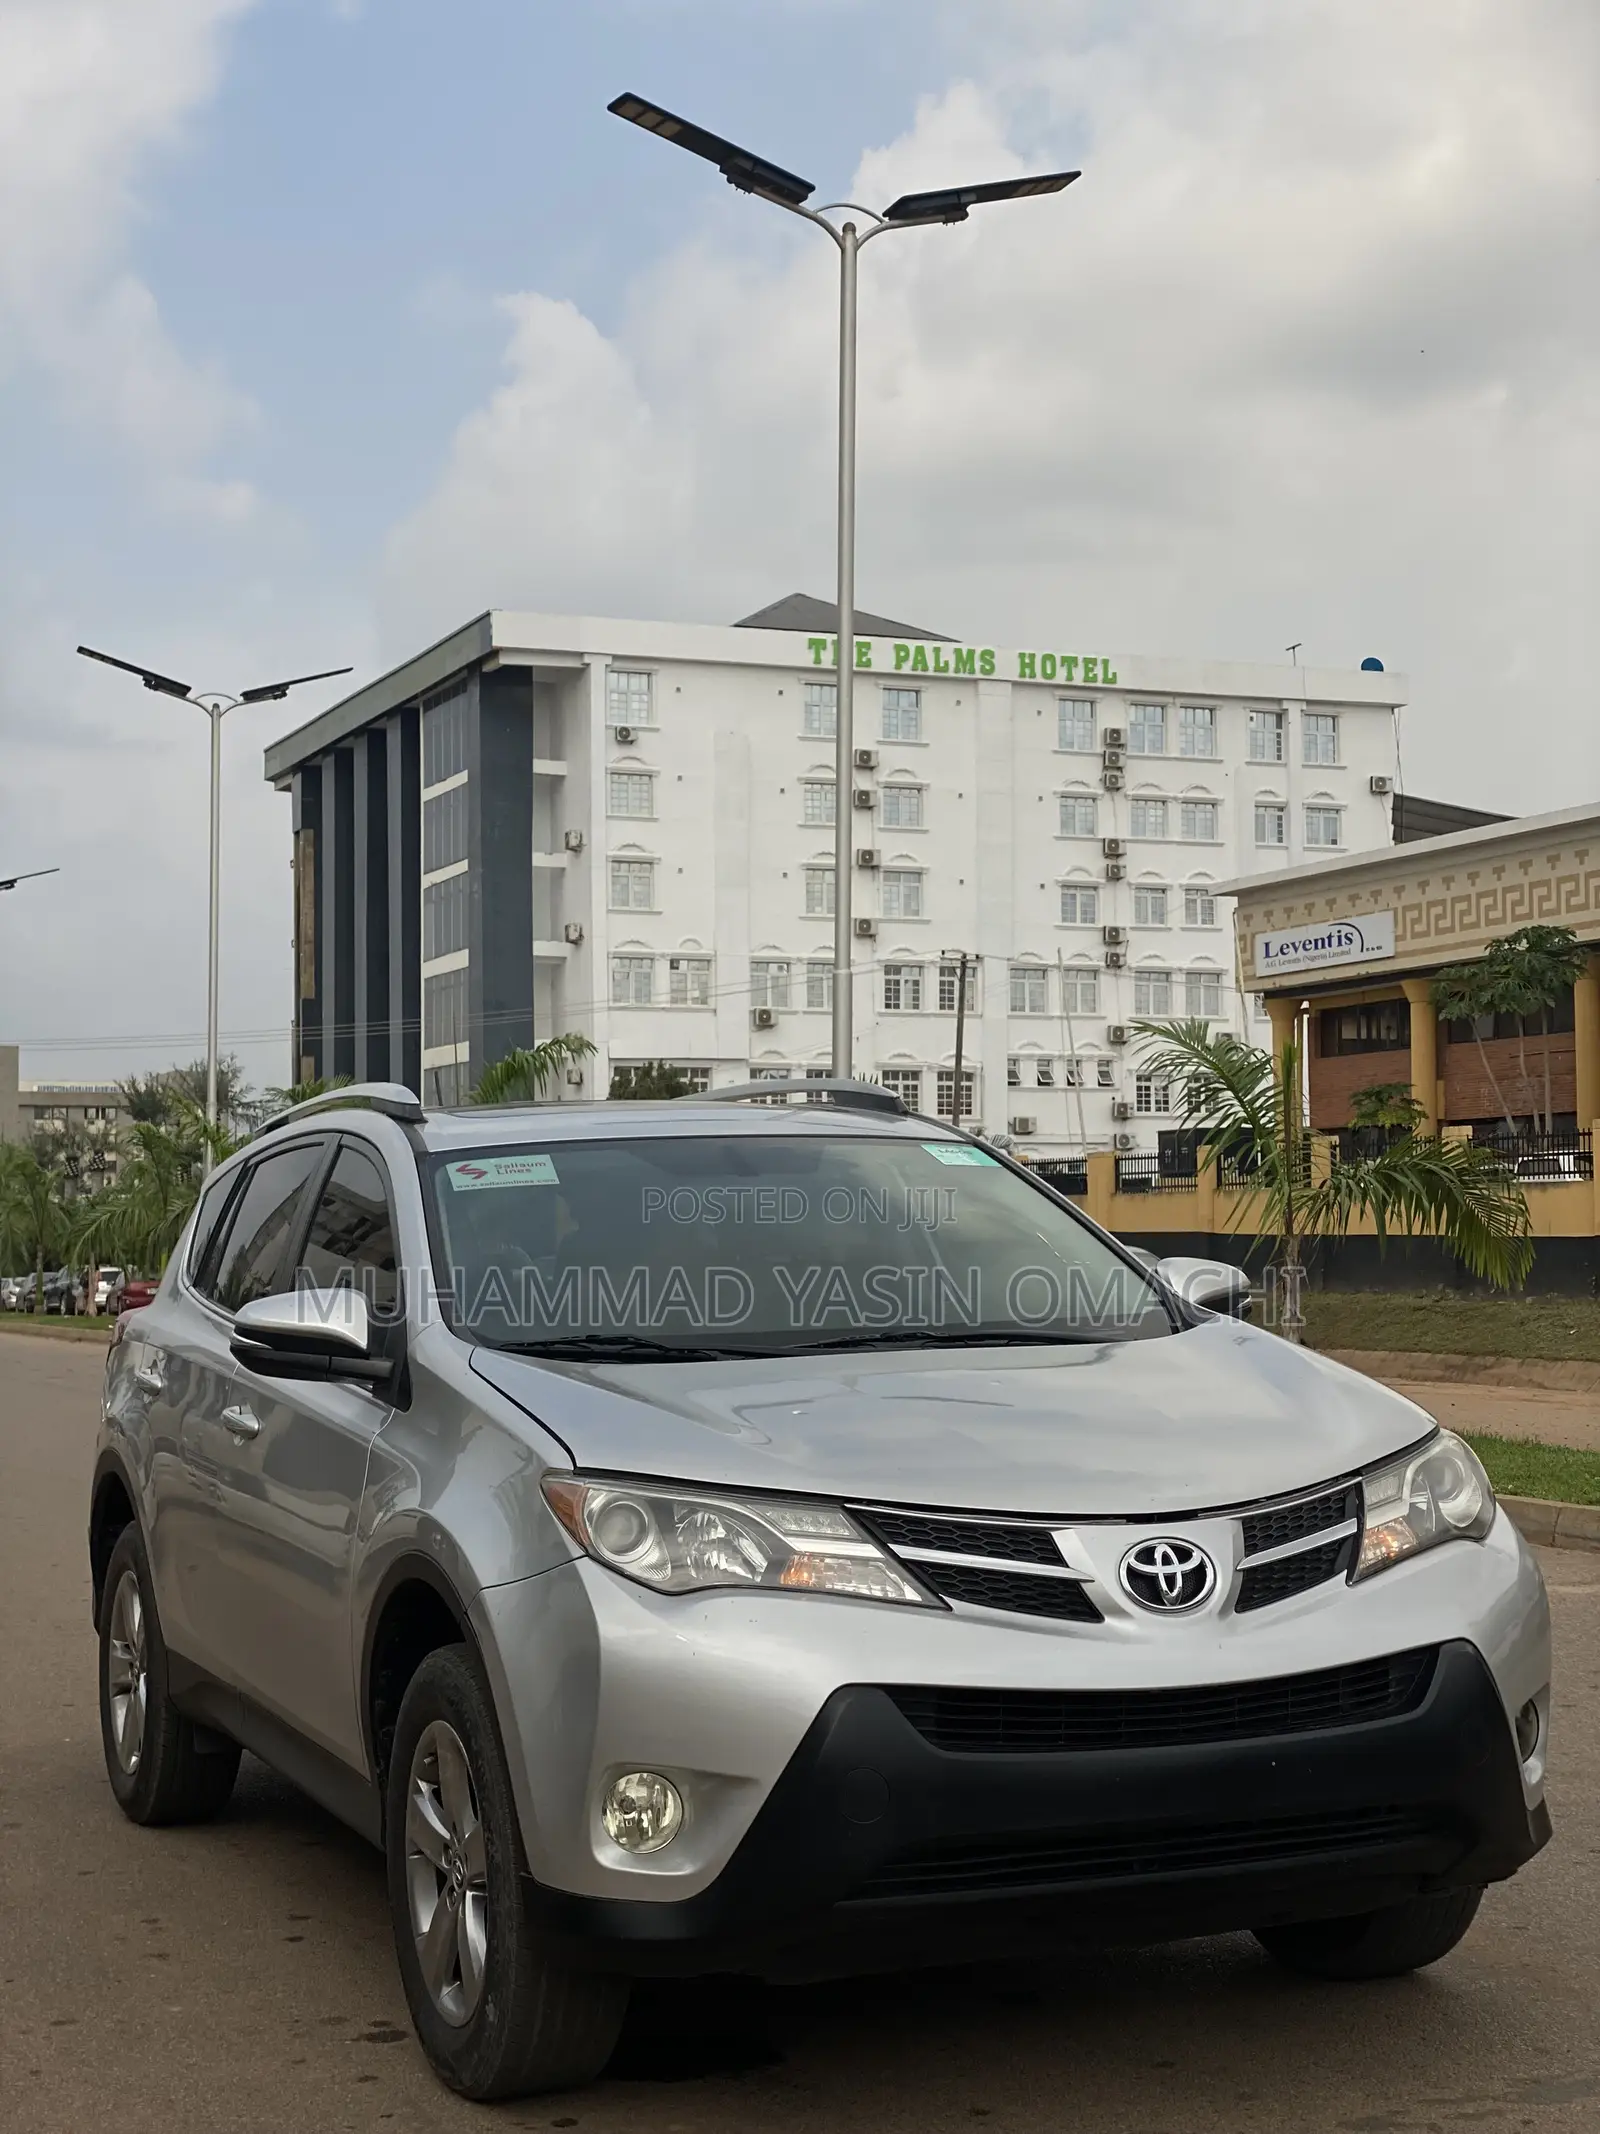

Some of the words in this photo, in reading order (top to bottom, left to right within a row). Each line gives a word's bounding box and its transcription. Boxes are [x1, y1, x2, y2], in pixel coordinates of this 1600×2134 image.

[893, 643, 996, 676] PALMS
[1018, 652, 1118, 685] HOTEL
[1263, 929, 1354, 960] Leventis
